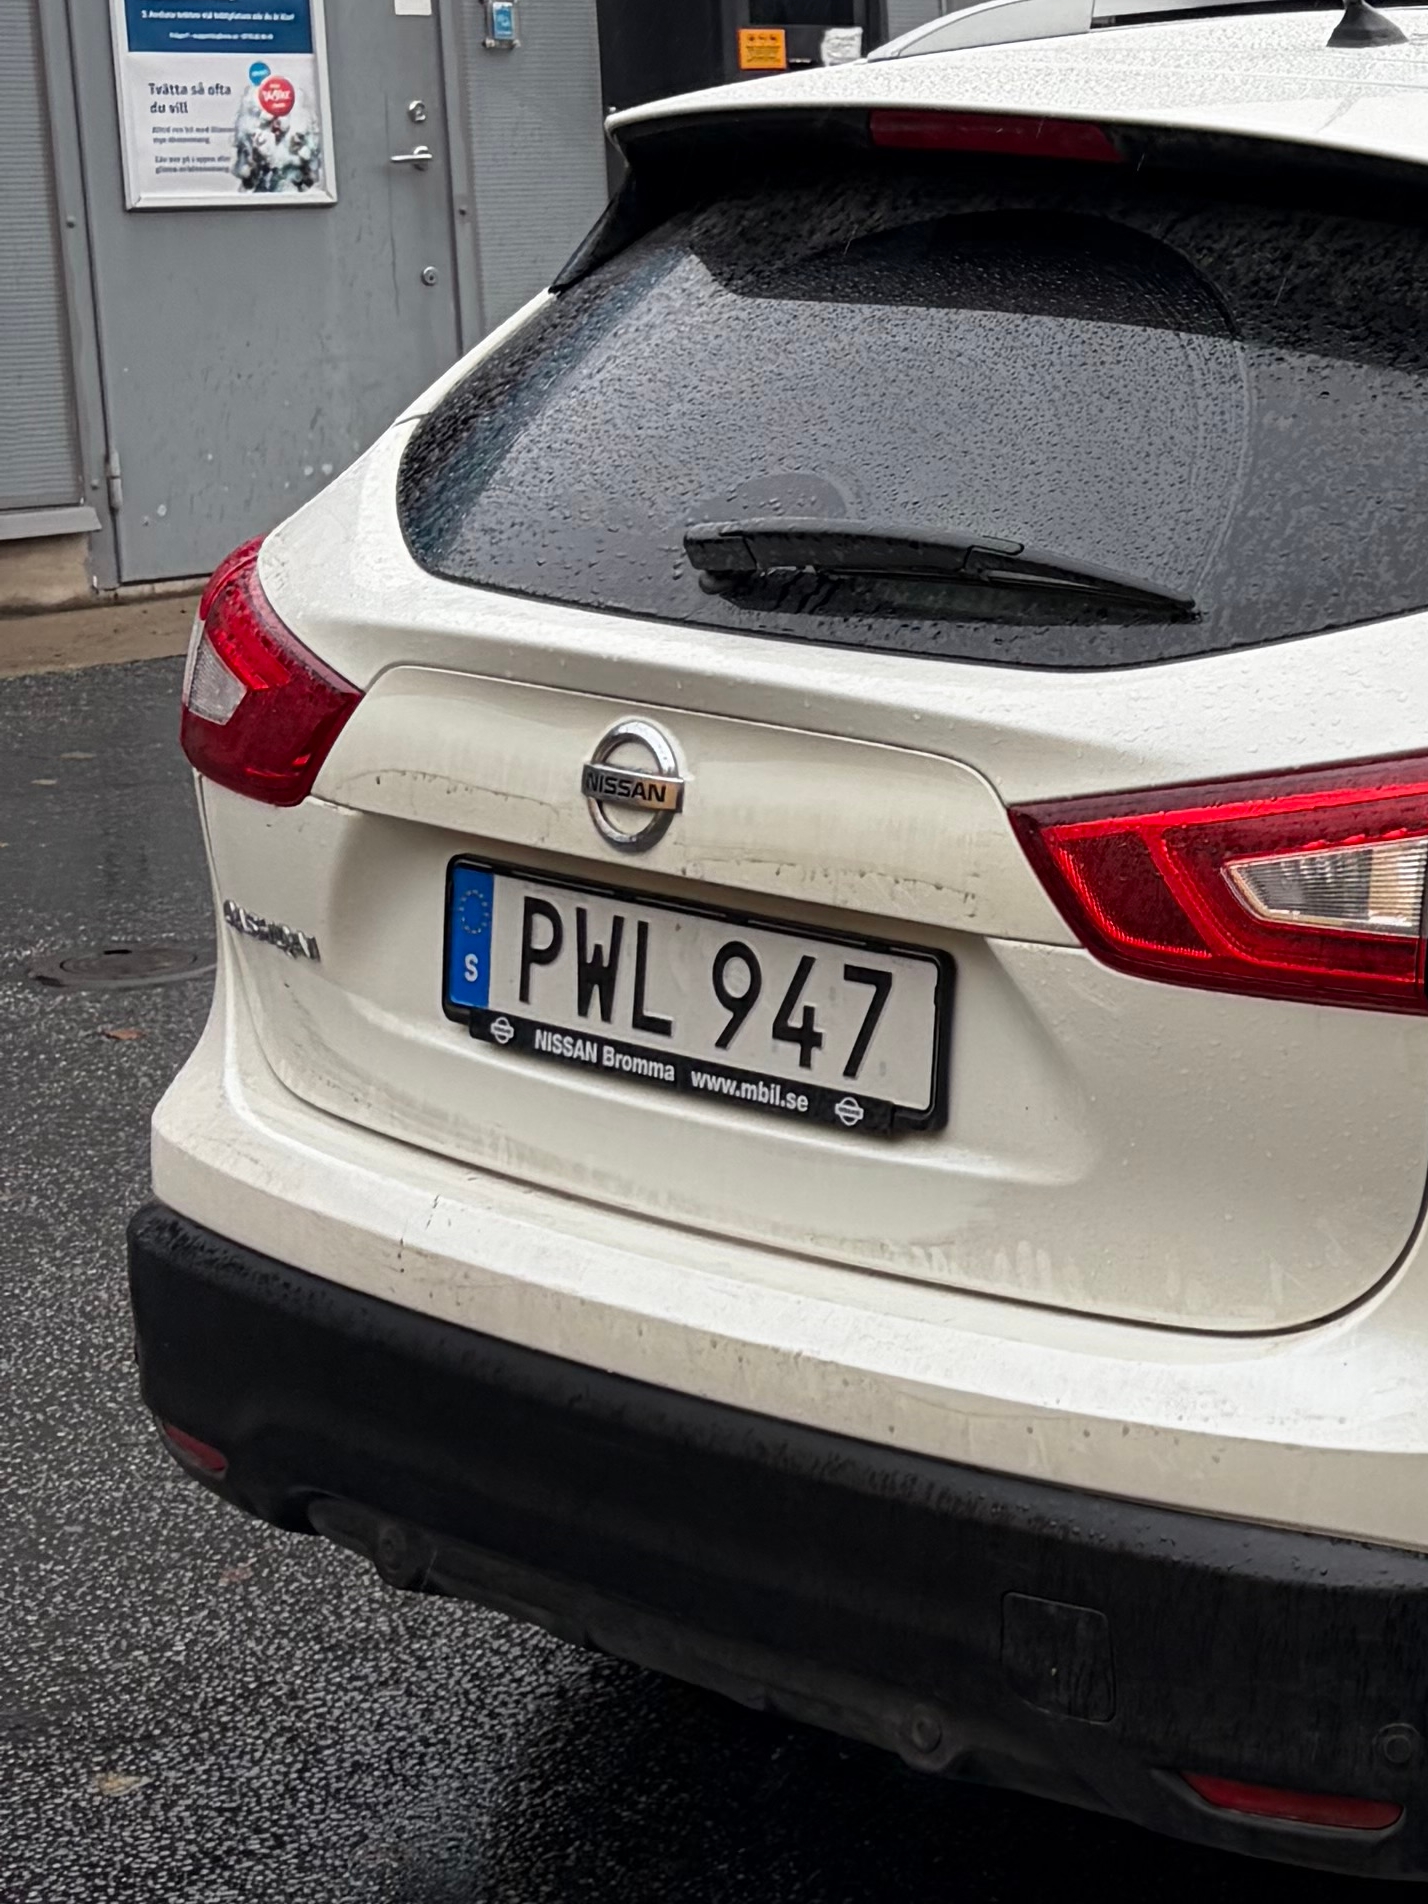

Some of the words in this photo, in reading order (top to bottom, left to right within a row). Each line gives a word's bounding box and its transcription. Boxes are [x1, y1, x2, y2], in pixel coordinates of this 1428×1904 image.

[148, 82, 188, 96] Tvätta
[190, 82, 206, 96] så
[207, 82, 232, 96] ofta
[149, 102, 167, 114] du
[168, 101, 189, 114] vill
[586, 772, 667, 803] NISSAN
[463, 953, 479, 982] S
[518, 895, 674, 1039] PWL
[711, 939, 894, 1081] 947
[534, 1029, 598, 1064] NISSAN
[602, 1046, 675, 1082] Bromma
[691, 1070, 810, 1112] www.mbil.se
